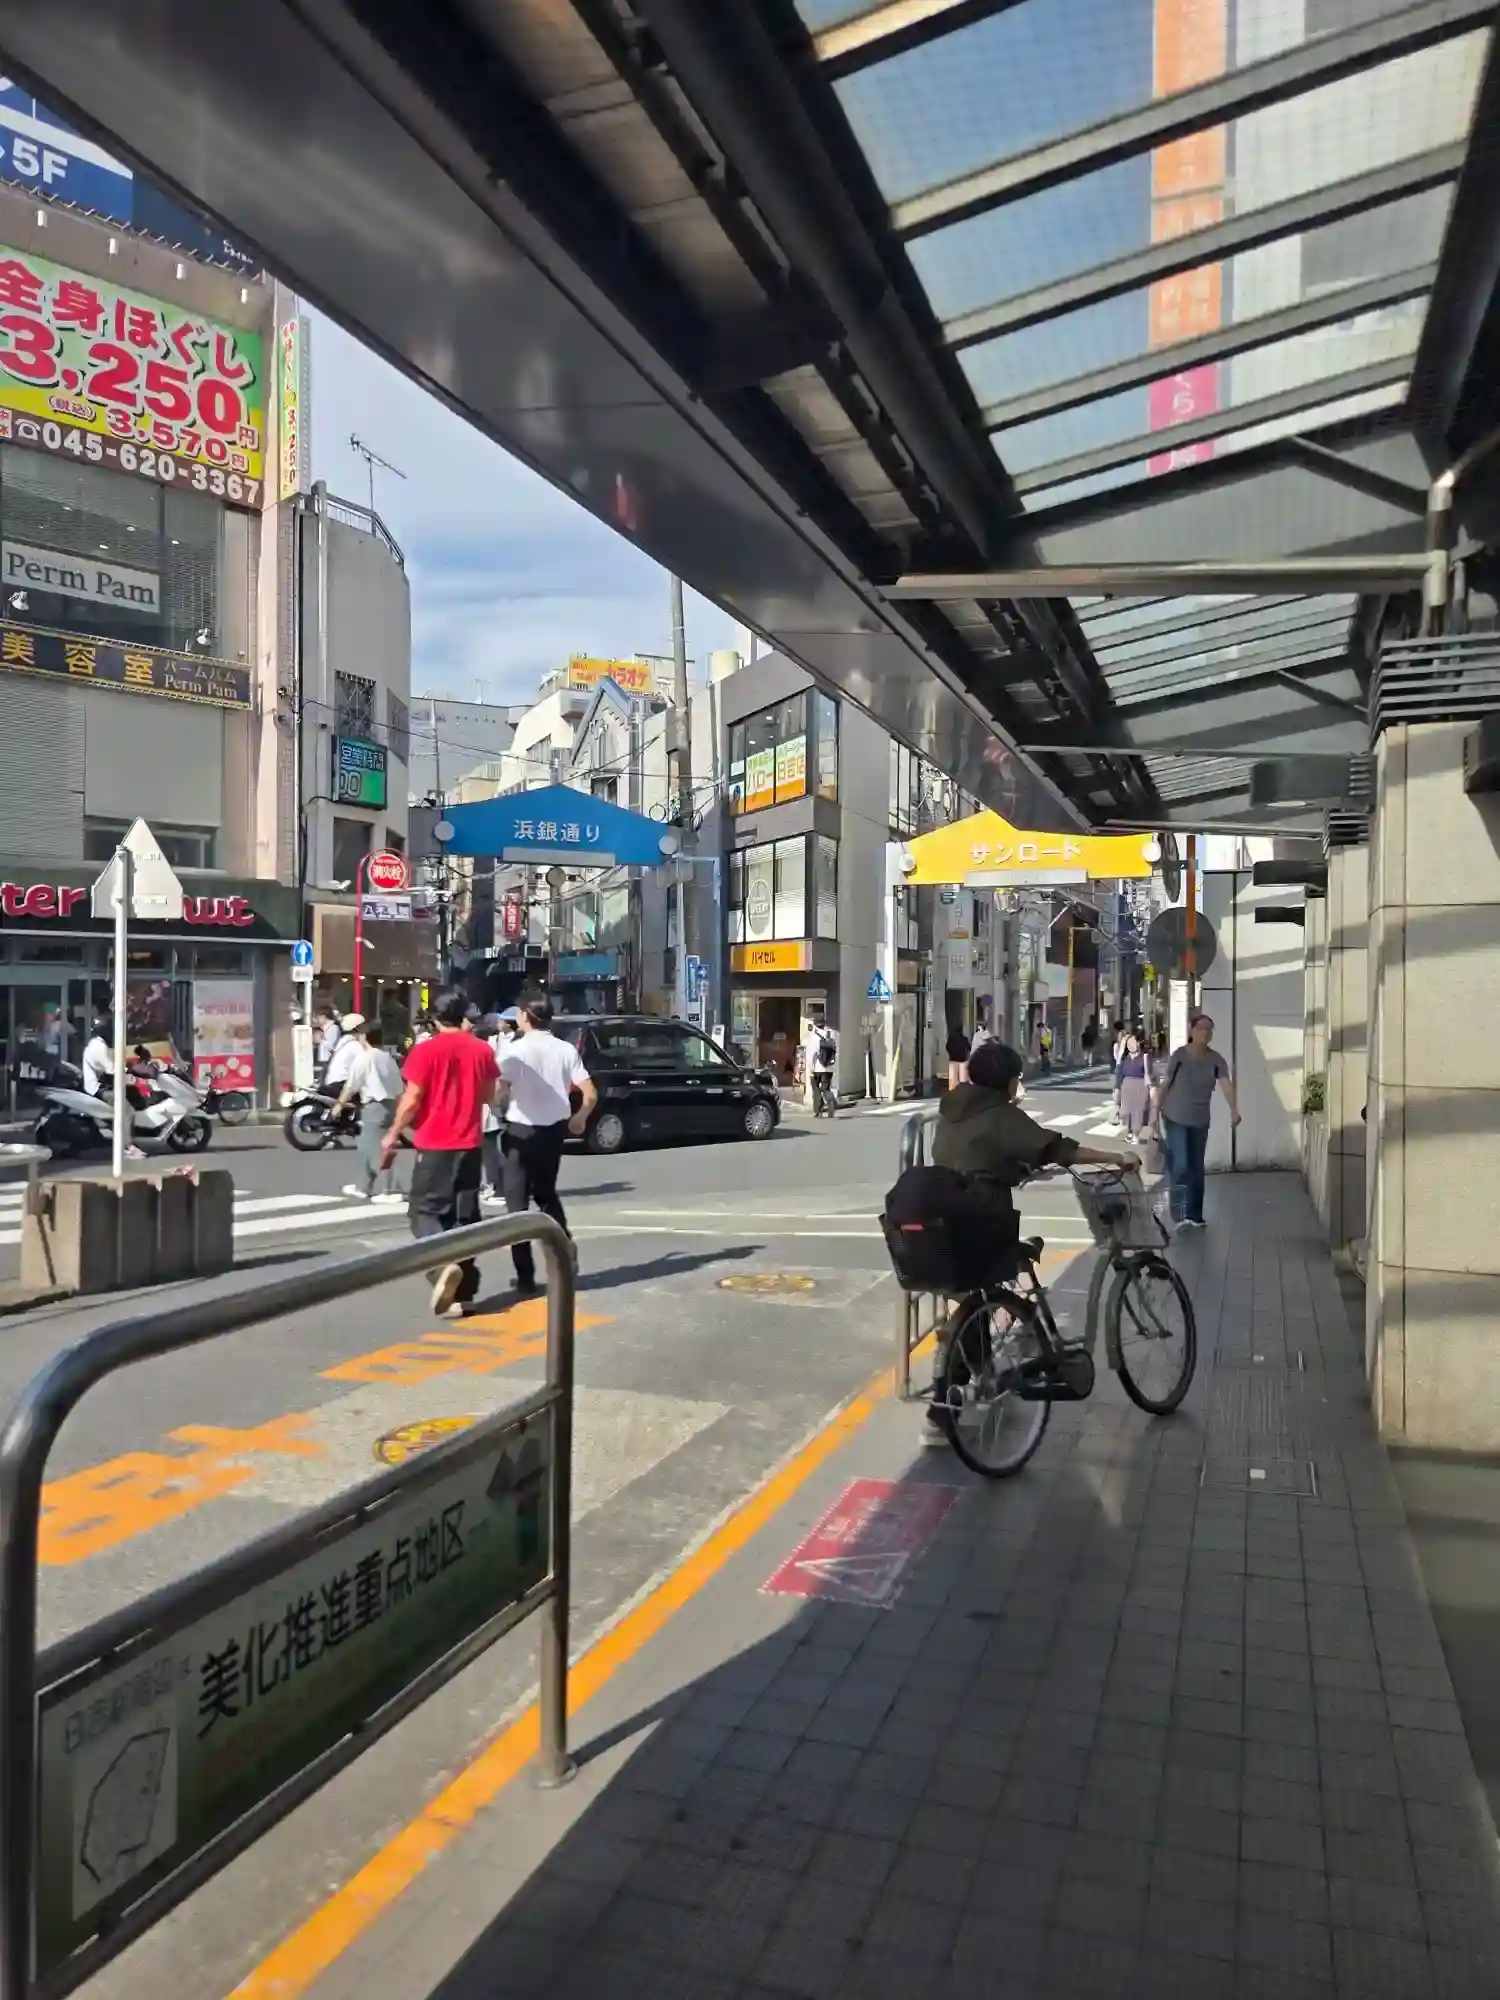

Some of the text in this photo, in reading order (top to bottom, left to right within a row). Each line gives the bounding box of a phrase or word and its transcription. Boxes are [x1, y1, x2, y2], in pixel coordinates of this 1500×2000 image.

[0, 259, 247, 380] 全身ほぐし
[42, 421, 260, 505] 045-620-3367
[6, 551, 156, 606] Perm Pam
[3, 631, 155, 686] 美容室
[164, 673, 237, 699] Perm Pam
[513, 819, 600, 843] 浜銀通り
[970, 841, 1082, 865] サンロード
[197, 1499, 466, 1740] 美化推進重点地区
